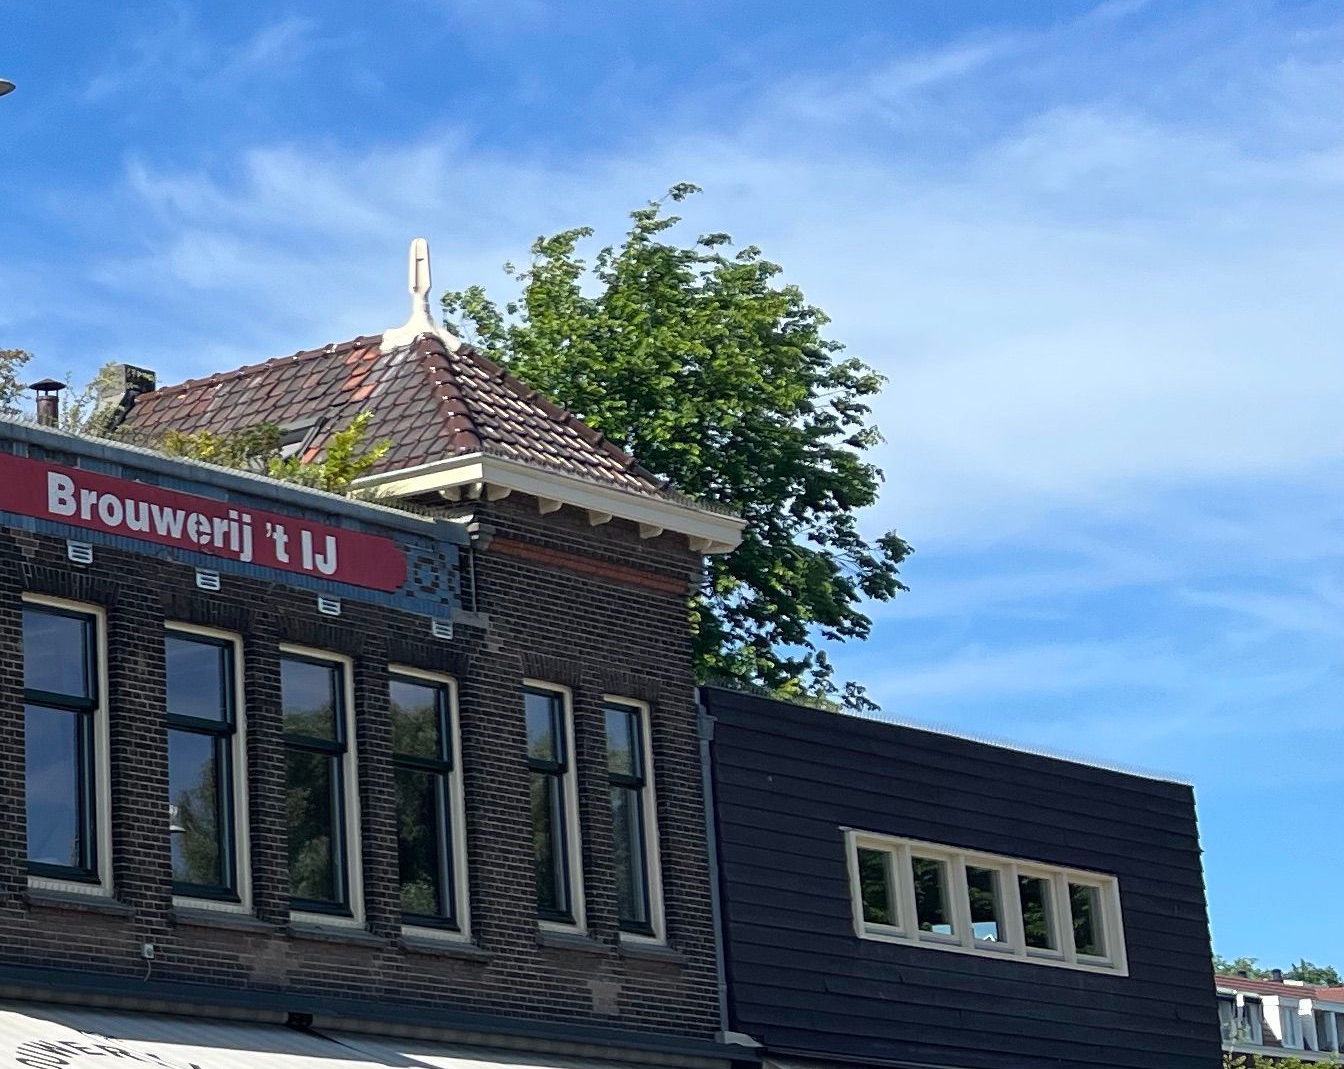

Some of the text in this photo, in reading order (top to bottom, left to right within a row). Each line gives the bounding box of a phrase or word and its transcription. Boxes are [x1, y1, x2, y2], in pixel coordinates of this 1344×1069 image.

[47, 471, 337, 575] Brouwerij 't IJ
